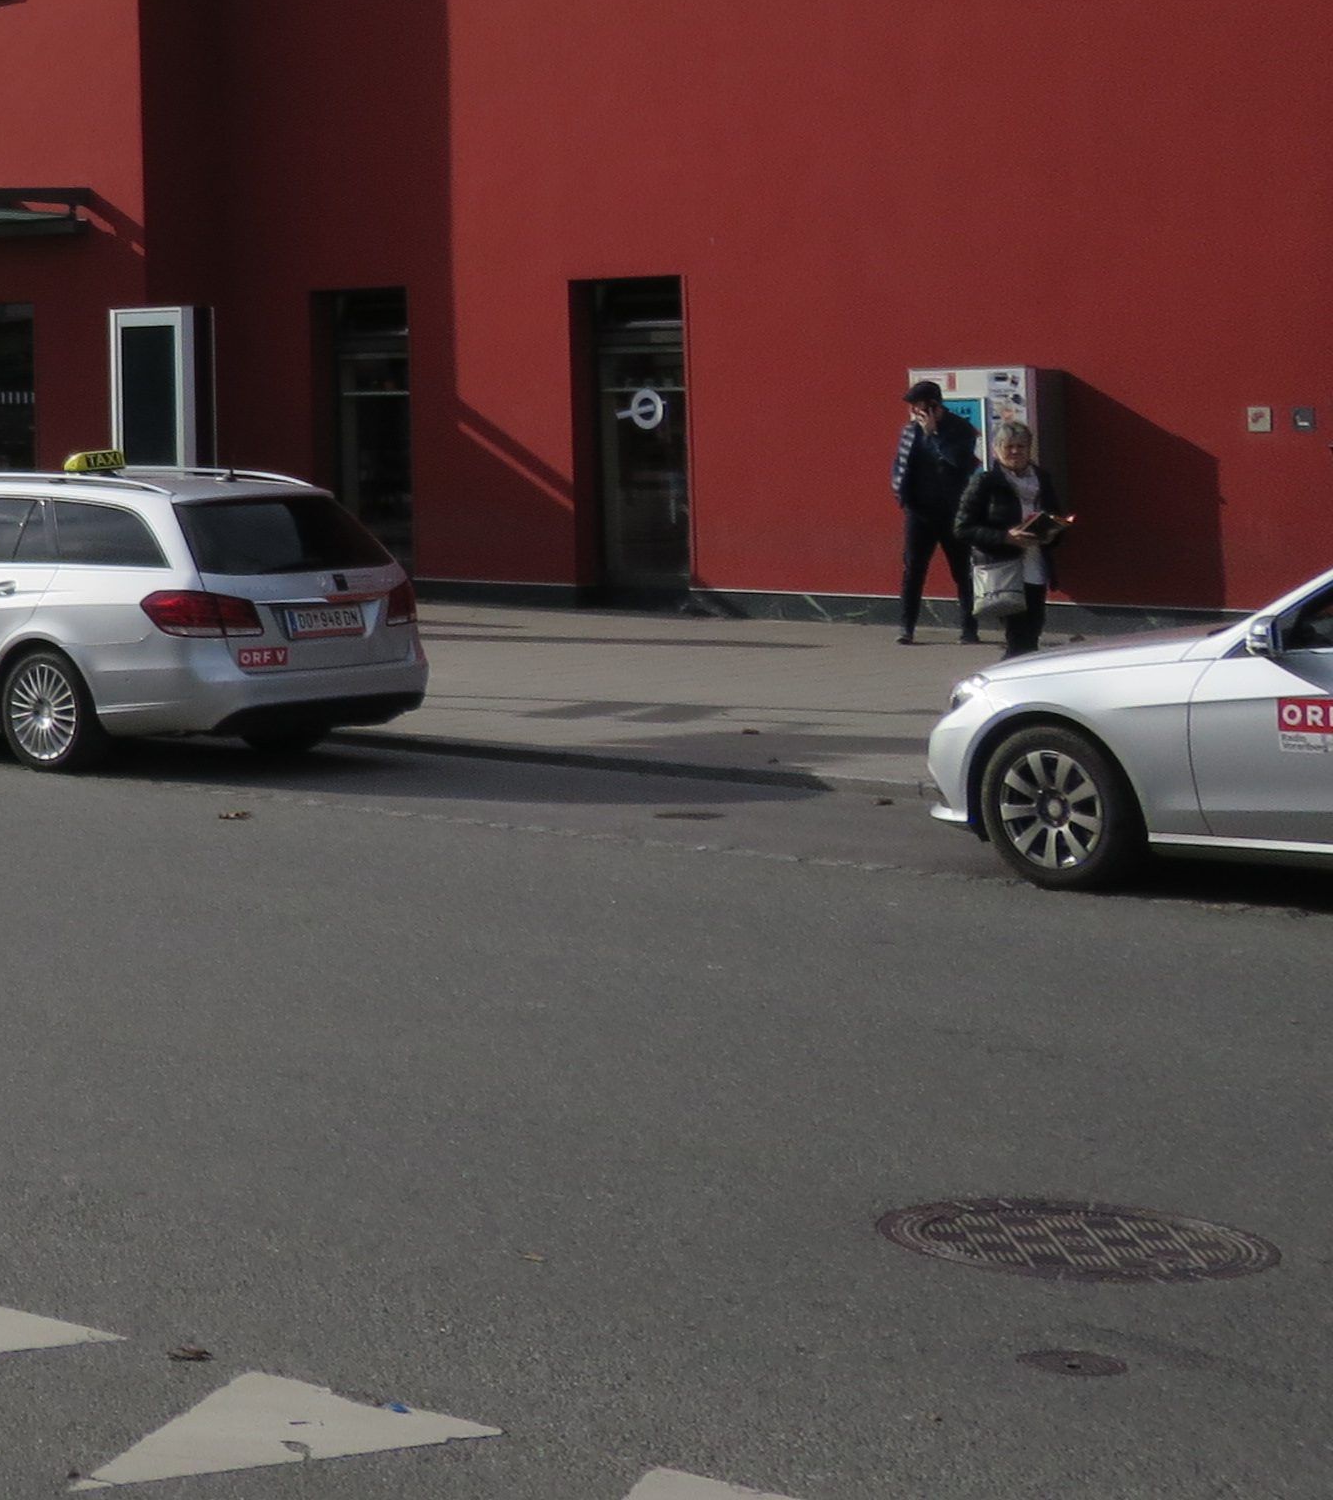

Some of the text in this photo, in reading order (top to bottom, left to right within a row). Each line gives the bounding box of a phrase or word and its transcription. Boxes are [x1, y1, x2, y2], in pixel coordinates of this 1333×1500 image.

[86, 453, 121, 469] TAXI
[321, 611, 343, 628] 948
[344, 609, 359, 625] DN
[240, 649, 286, 665] ORF V
[1282, 704, 1333, 728] OR
